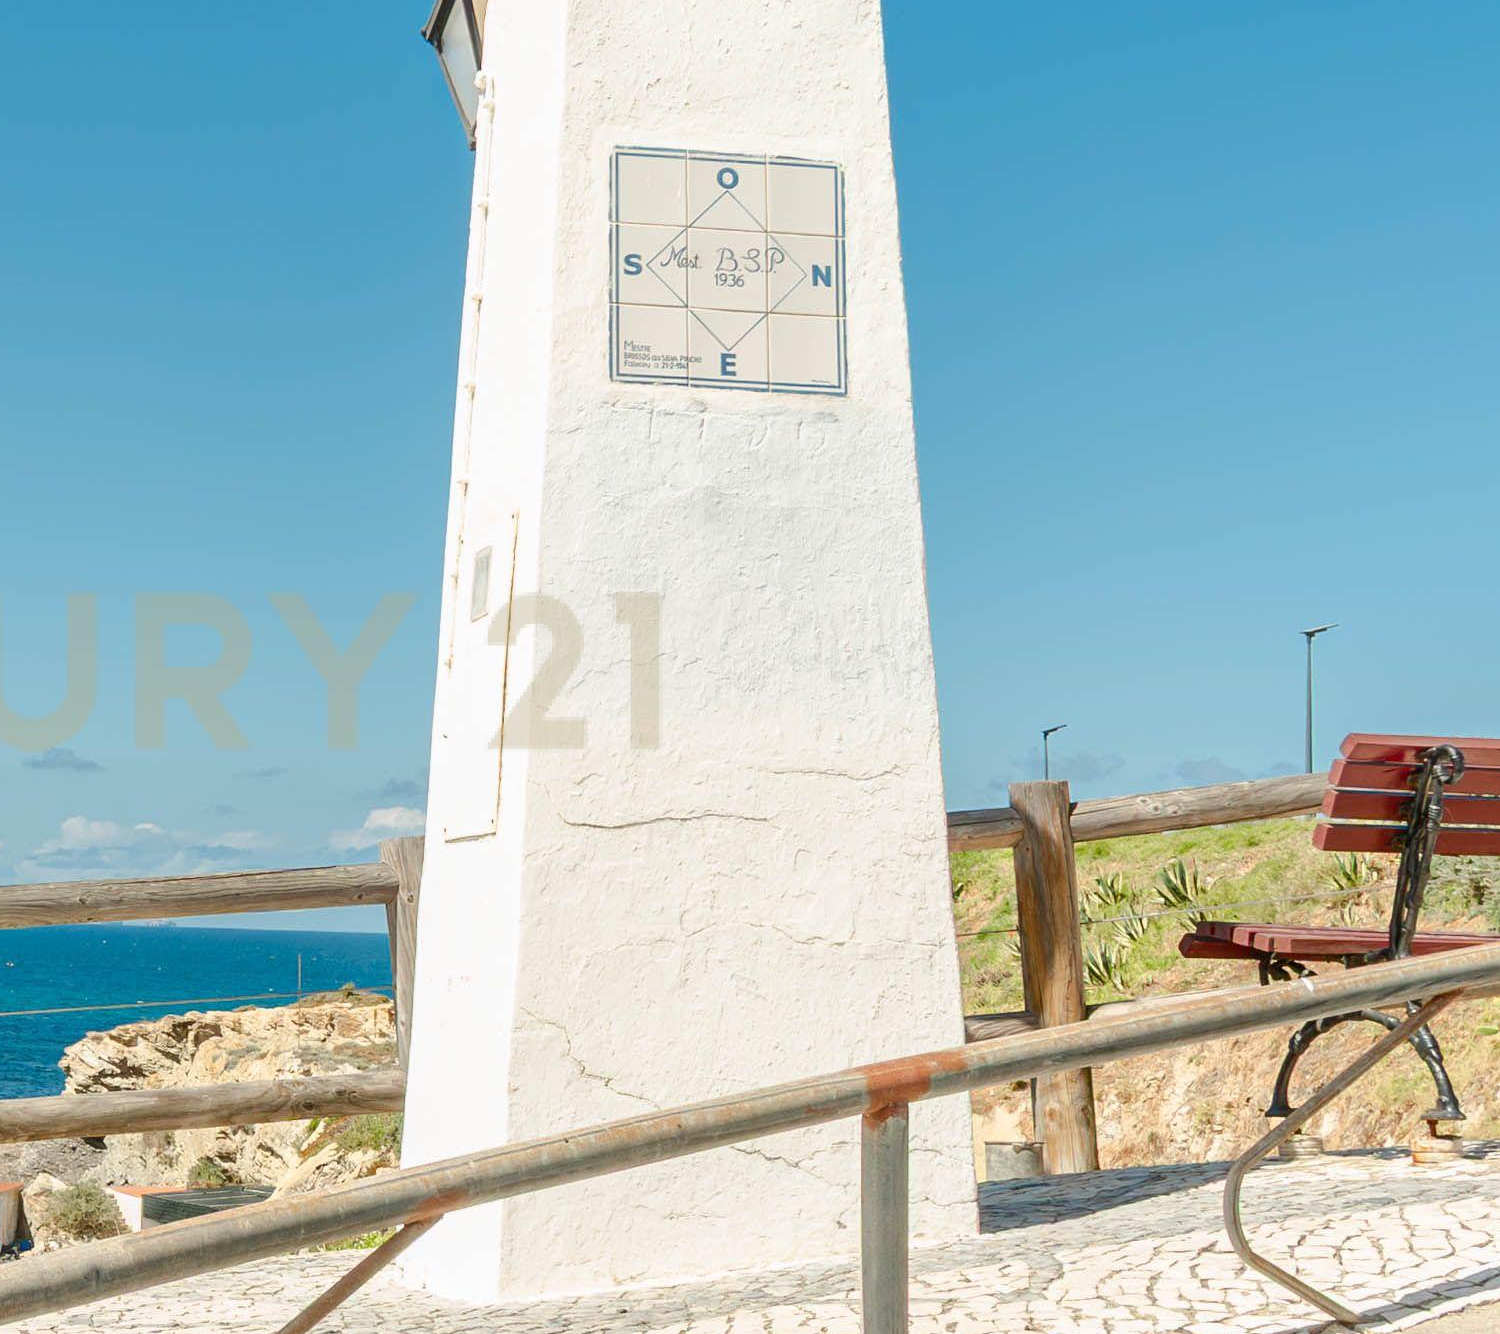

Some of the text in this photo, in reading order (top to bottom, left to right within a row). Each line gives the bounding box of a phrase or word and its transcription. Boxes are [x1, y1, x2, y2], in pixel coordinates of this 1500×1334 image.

[717, 167, 739, 189] O
[623, 253, 643, 276] S
[811, 264, 832, 288] N
[714, 273, 745, 288] 1936
[720, 353, 737, 377] E
